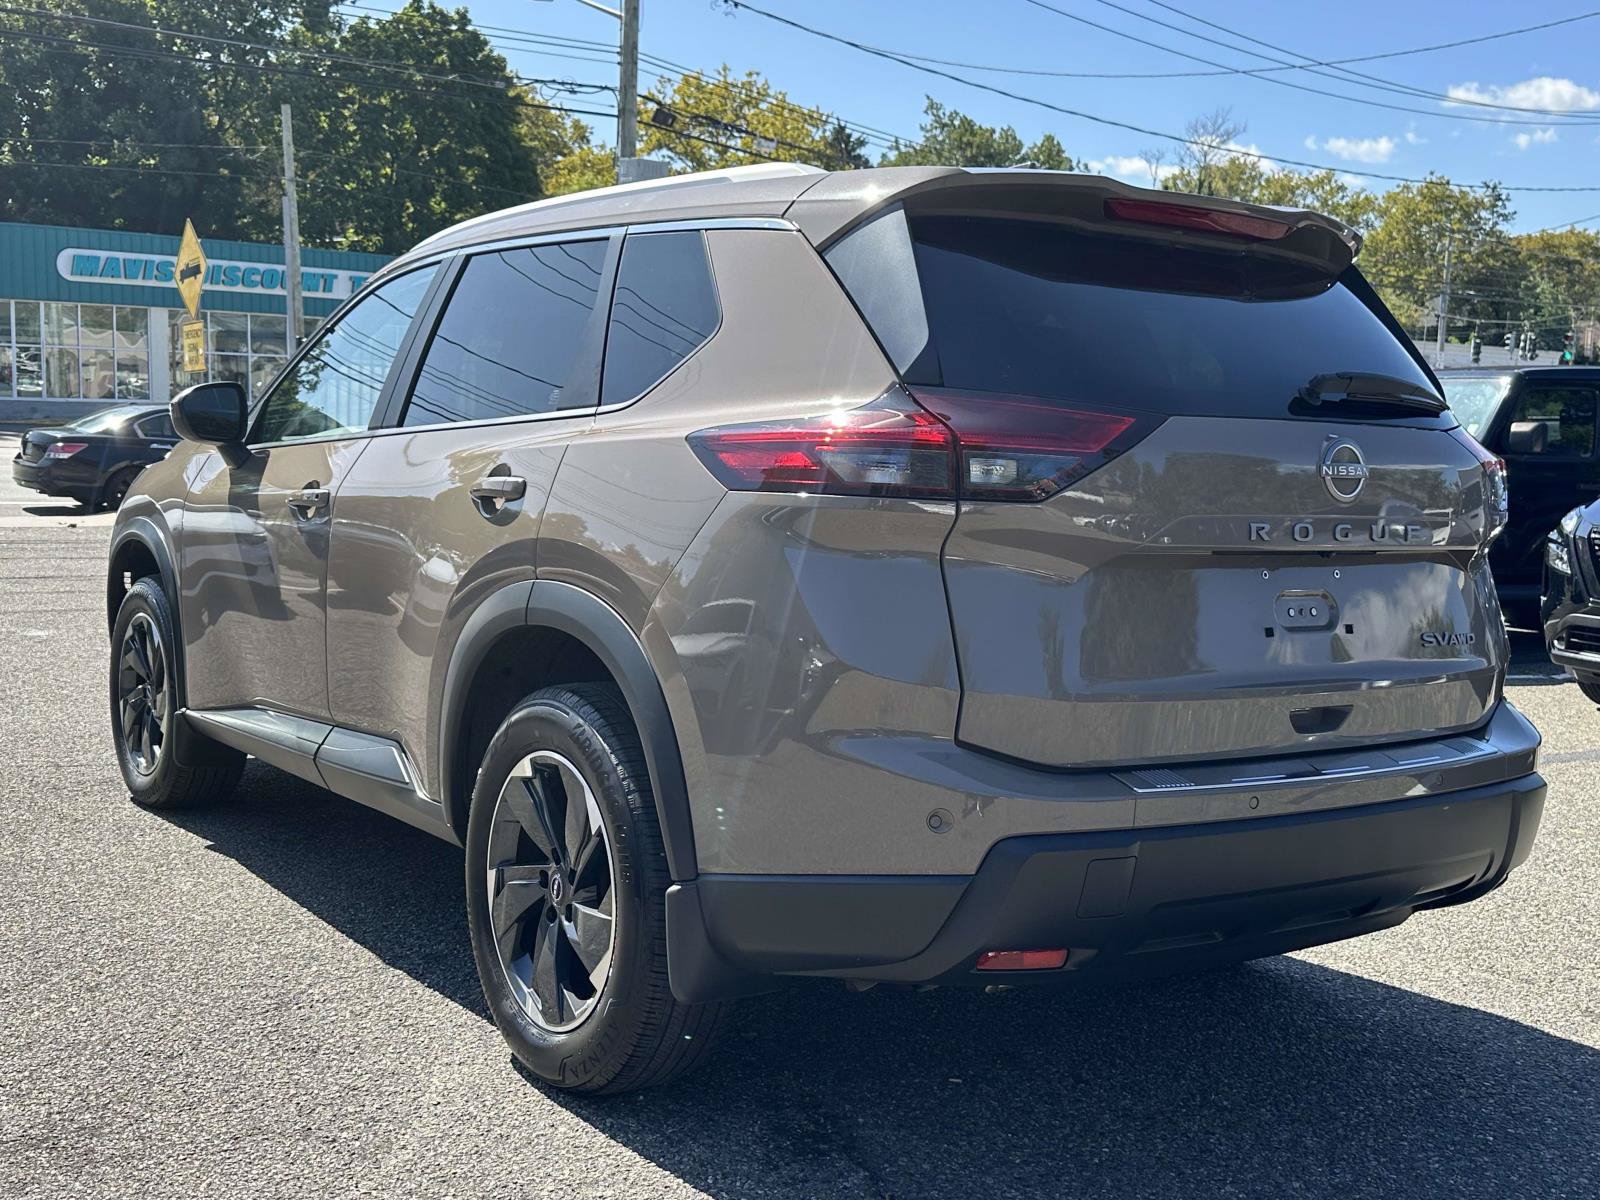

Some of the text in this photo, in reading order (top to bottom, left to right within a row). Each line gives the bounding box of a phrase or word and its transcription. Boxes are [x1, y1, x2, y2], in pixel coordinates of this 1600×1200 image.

[71, 254, 175, 283] MAVIS
[1322, 465, 1369, 477] NISSAN
[1249, 521, 1428, 543] ROGUE
